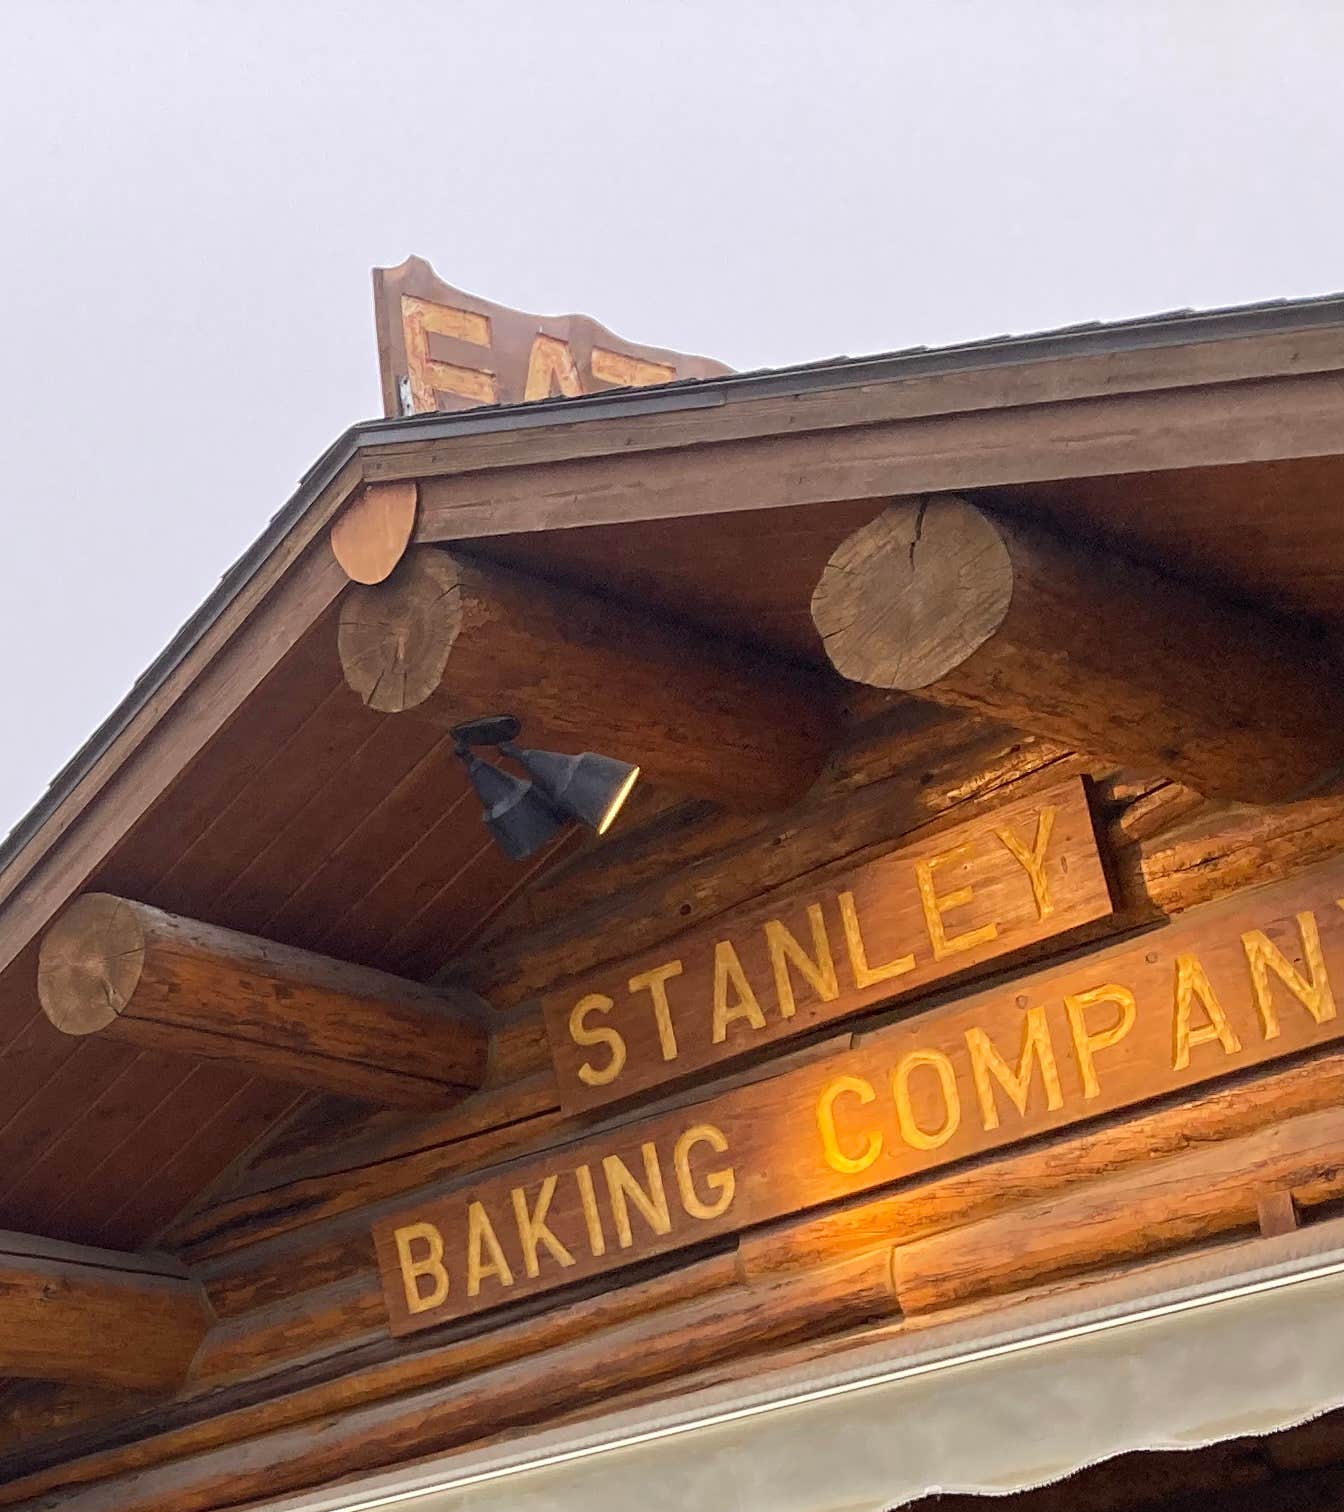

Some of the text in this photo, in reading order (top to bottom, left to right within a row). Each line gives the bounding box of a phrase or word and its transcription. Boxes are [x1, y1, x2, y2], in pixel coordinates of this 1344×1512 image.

[393, 897, 1344, 1315] BAKING COMPAN
[567, 805, 1057, 1087] STANLEY
